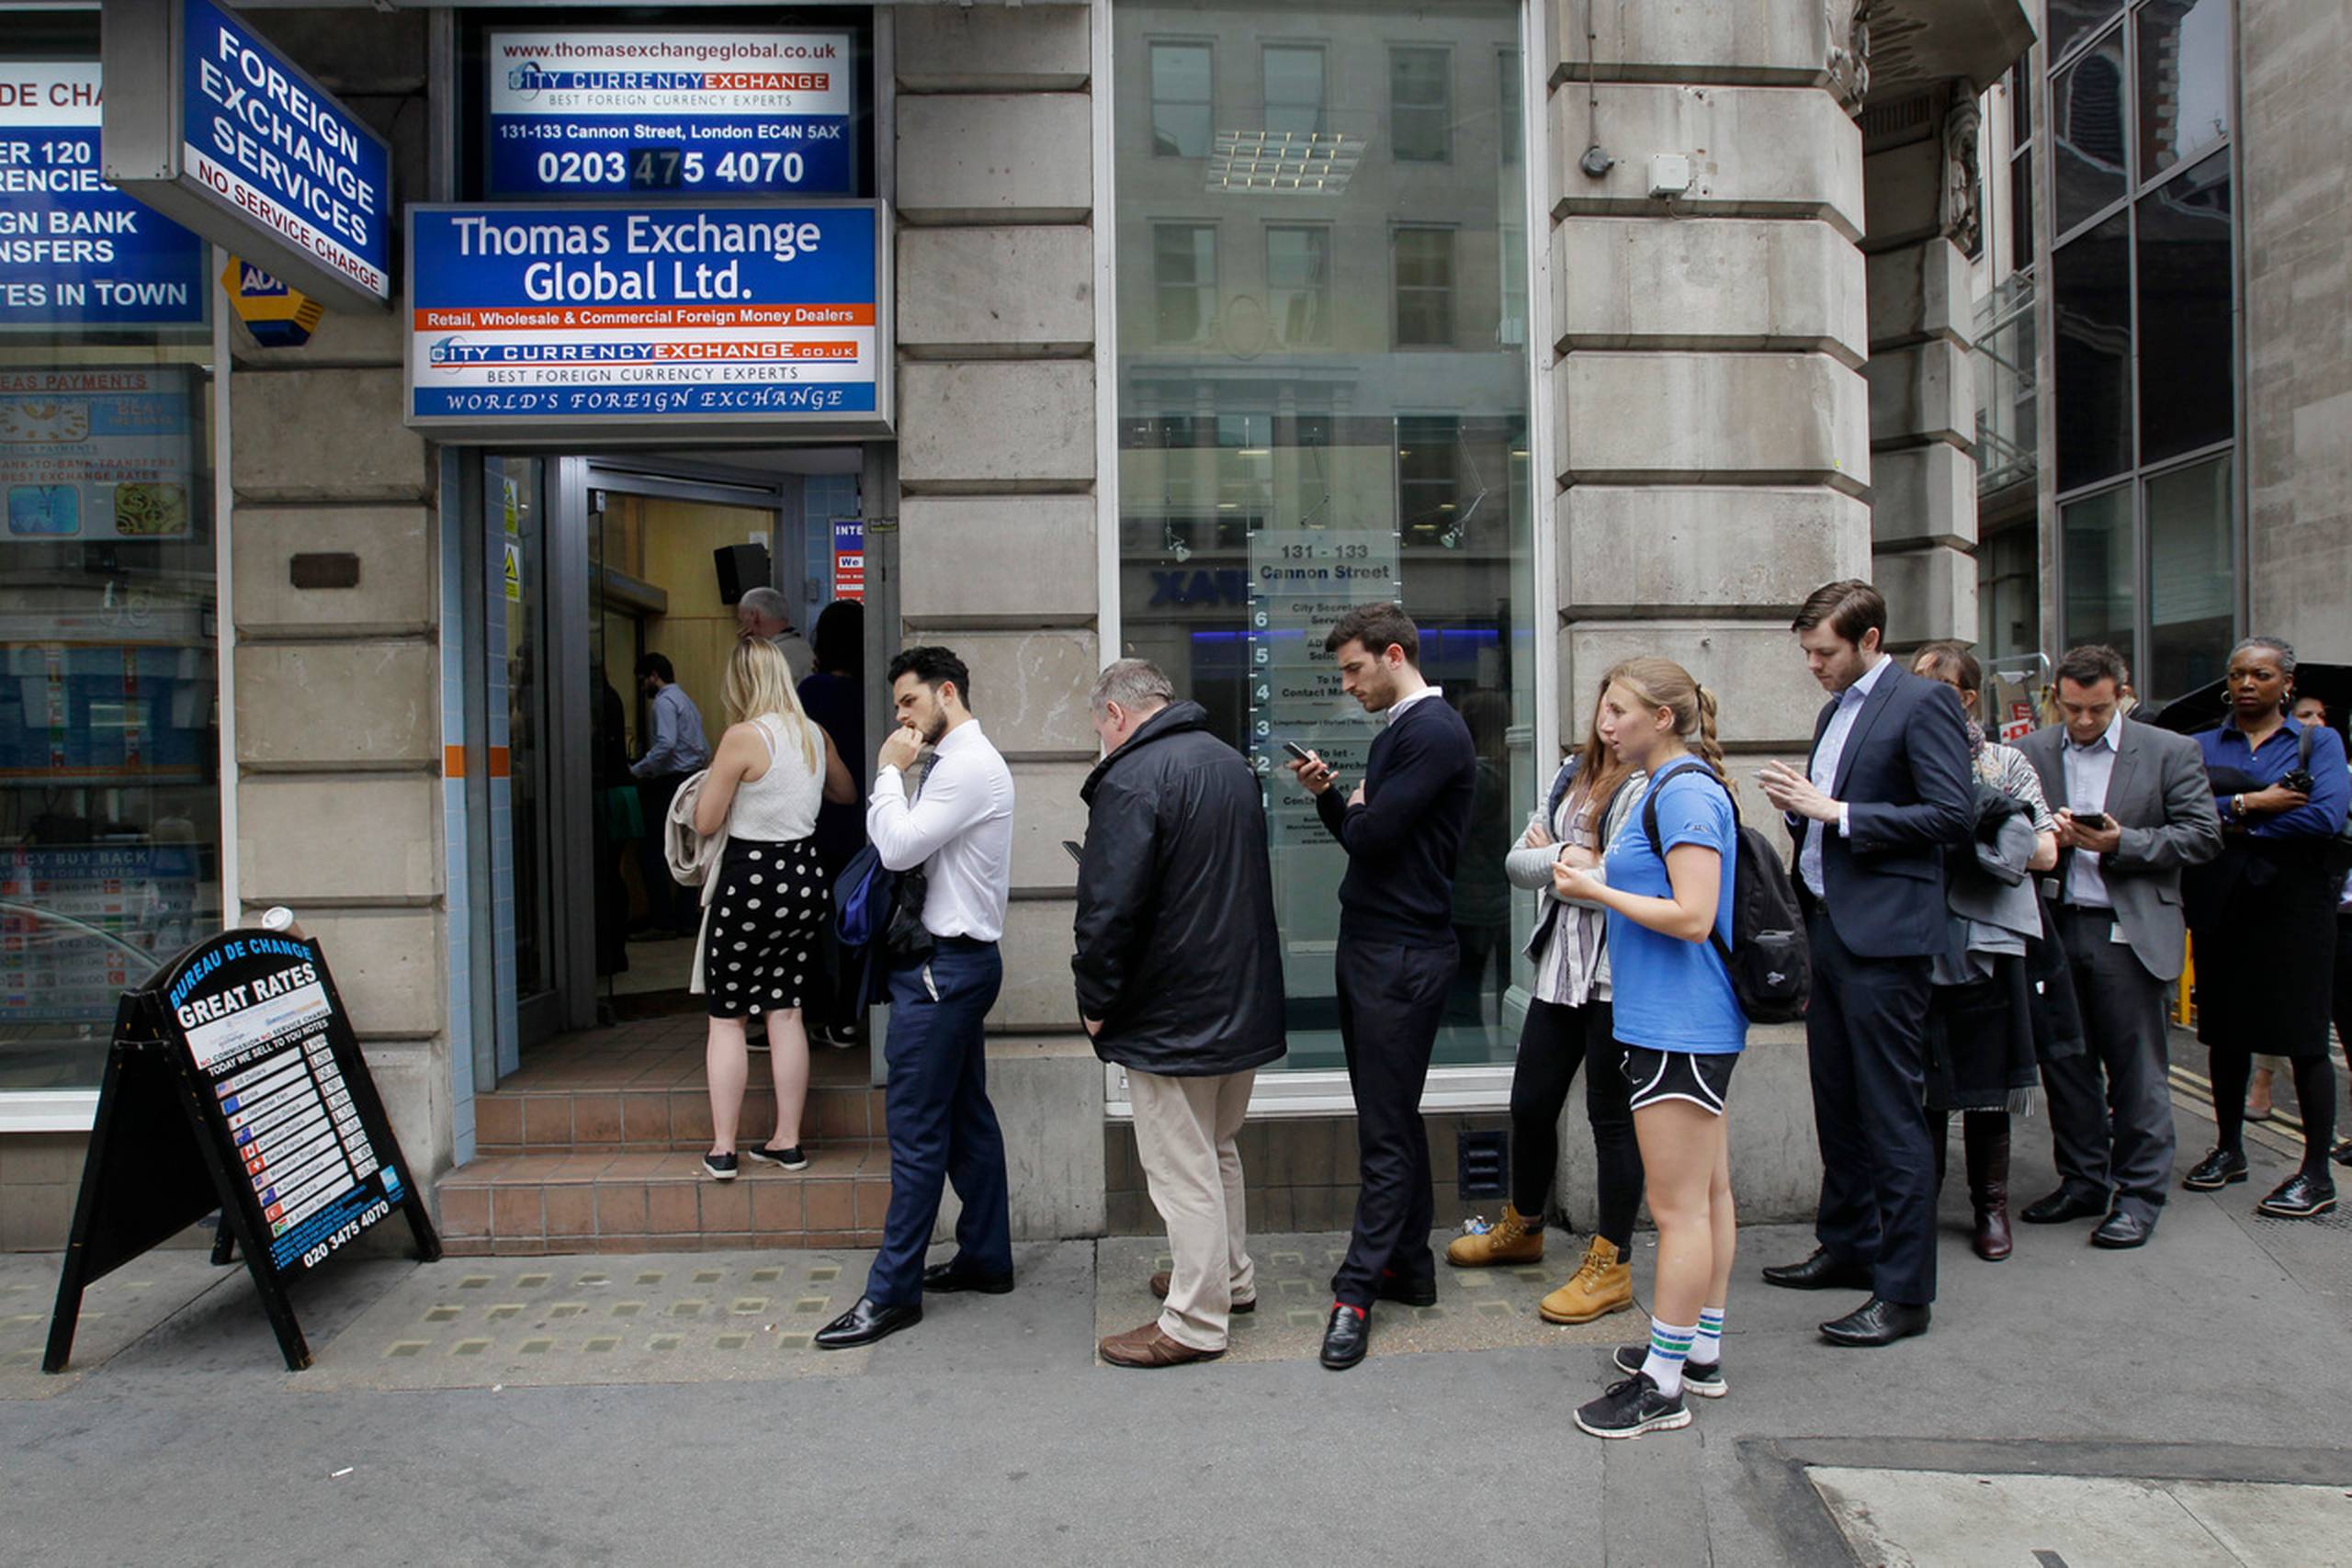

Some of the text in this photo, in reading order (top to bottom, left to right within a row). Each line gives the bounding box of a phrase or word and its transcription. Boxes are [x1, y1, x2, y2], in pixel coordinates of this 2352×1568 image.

[503, 42, 836, 61] www.thomasexchangeglobal.co.uk
[509, 72, 560, 90] CITY
[0, 83, 38, 107] DE
[219, 27, 358, 164] FOREIGN
[549, 95, 792, 107] BEST FOREIGN CURRENCY EXPERTS
[201, 58, 375, 215] EXCHANGE
[500, 124, 841, 141] 131-133 Cannon Street, London EC4N 5AX
[41, 141, 91, 164] 120
[537, 151, 804, 185] 0203 475 4070
[0, 169, 119, 193] ENCIE
[213, 117, 368, 246] SERVICES
[49, 210, 138, 234] BANK
[198, 160, 379, 291] NO SERVICE CHARGE
[451, 213, 821, 262] Thomas Exchange
[241, 267, 282, 291] AD
[525, 260, 752, 301] Global Ltd.
[56, 283, 85, 306] IN
[95, 283, 187, 307] TOWN
[428, 308, 854, 327] Retail, Wholesale & Commercial Foreign Money Dealers
[431, 345, 490, 362] CITY
[47, 374, 147, 389] PAYMENTS
[487, 367, 798, 383] BEST FOREIGN CURRENCY EXPERTS
[447, 387, 842, 412] WORLD'S FOREIGN EXCHANGE
[40, 471, 111, 482] EXCHANGE
[117, 469, 160, 481] RATES
[1281, 545, 1314, 558] 131
[1335, 545, 1368, 558] 133
[841, 557, 860, 567] We
[1260, 564, 1390, 580] Cannon Street
[1292, 603, 1315, 614] City
[1255, 610, 1268, 627] 6
[1255, 648, 1269, 663] 5
[1317, 675, 1342, 685] To le
[1256, 684, 1271, 700] 4
[1282, 688, 1325, 698] Contact
[1256, 720, 1271, 736] 3
[1317, 749, 1330, 758] To
[1332, 748, 1347, 758] let
[1257, 756, 1271, 772] 2
[56, 852, 91, 864] BUY
[100, 851, 148, 864] BACK
[92, 866, 135, 877] NOTES
[169, 938, 314, 1010] BUREAU DE CHANGE
[176, 985, 249, 1030] GREAT
[252, 962, 317, 1002] RATES
[208, 1057, 238, 1077] TODAY
[236, 1052, 253, 1066] WE
[251, 1042, 274, 1059] SELL
[273, 1036, 287, 1049] TO
[285, 1028, 303, 1043] YOU
[301, 1018, 330, 1035] NOTES
[212, 1037, 260, 1063] COMMISSION
[243, 1066, 267, 1083] Dollars
[252, 1102, 301, 1134] Australian Dollars
[258, 1118, 307, 1147] Canadian Dollars
[303, 1243, 329, 1269] 020
[328, 1221, 360, 1250] 3475
[360, 1201, 390, 1227] 4070
